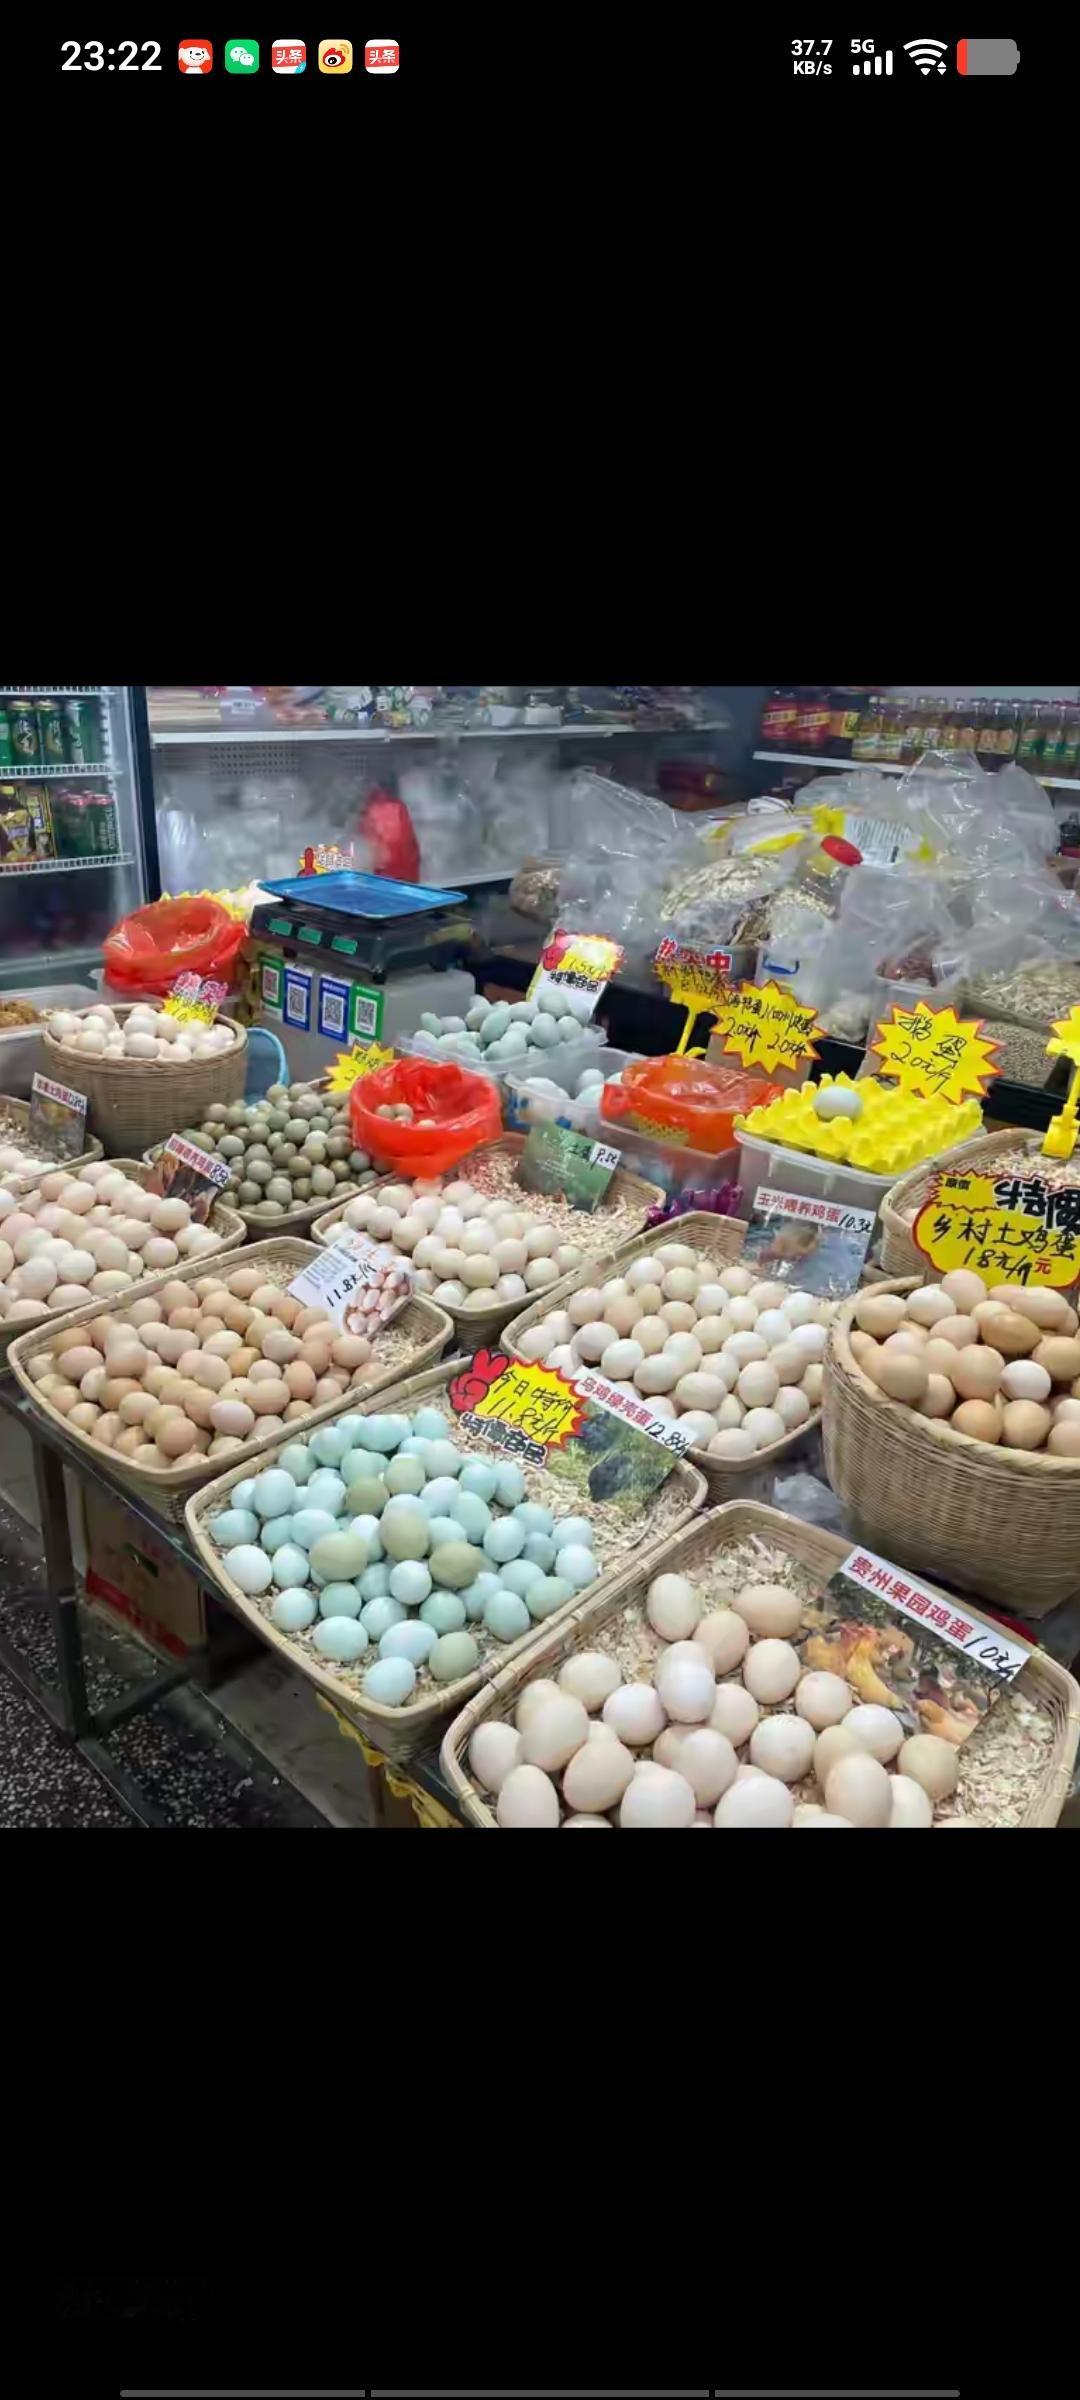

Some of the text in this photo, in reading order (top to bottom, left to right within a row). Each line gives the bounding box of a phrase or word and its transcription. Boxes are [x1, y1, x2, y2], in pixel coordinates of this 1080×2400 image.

[931, 1213, 1077, 1260] 乡村土鸡蛋
[1033, 1257, 1052, 1276] 元
[580, 1376, 654, 1427] 乌鸡绿壳蛋
[849, 1556, 975, 1642] 贵州果园鸡蛋
